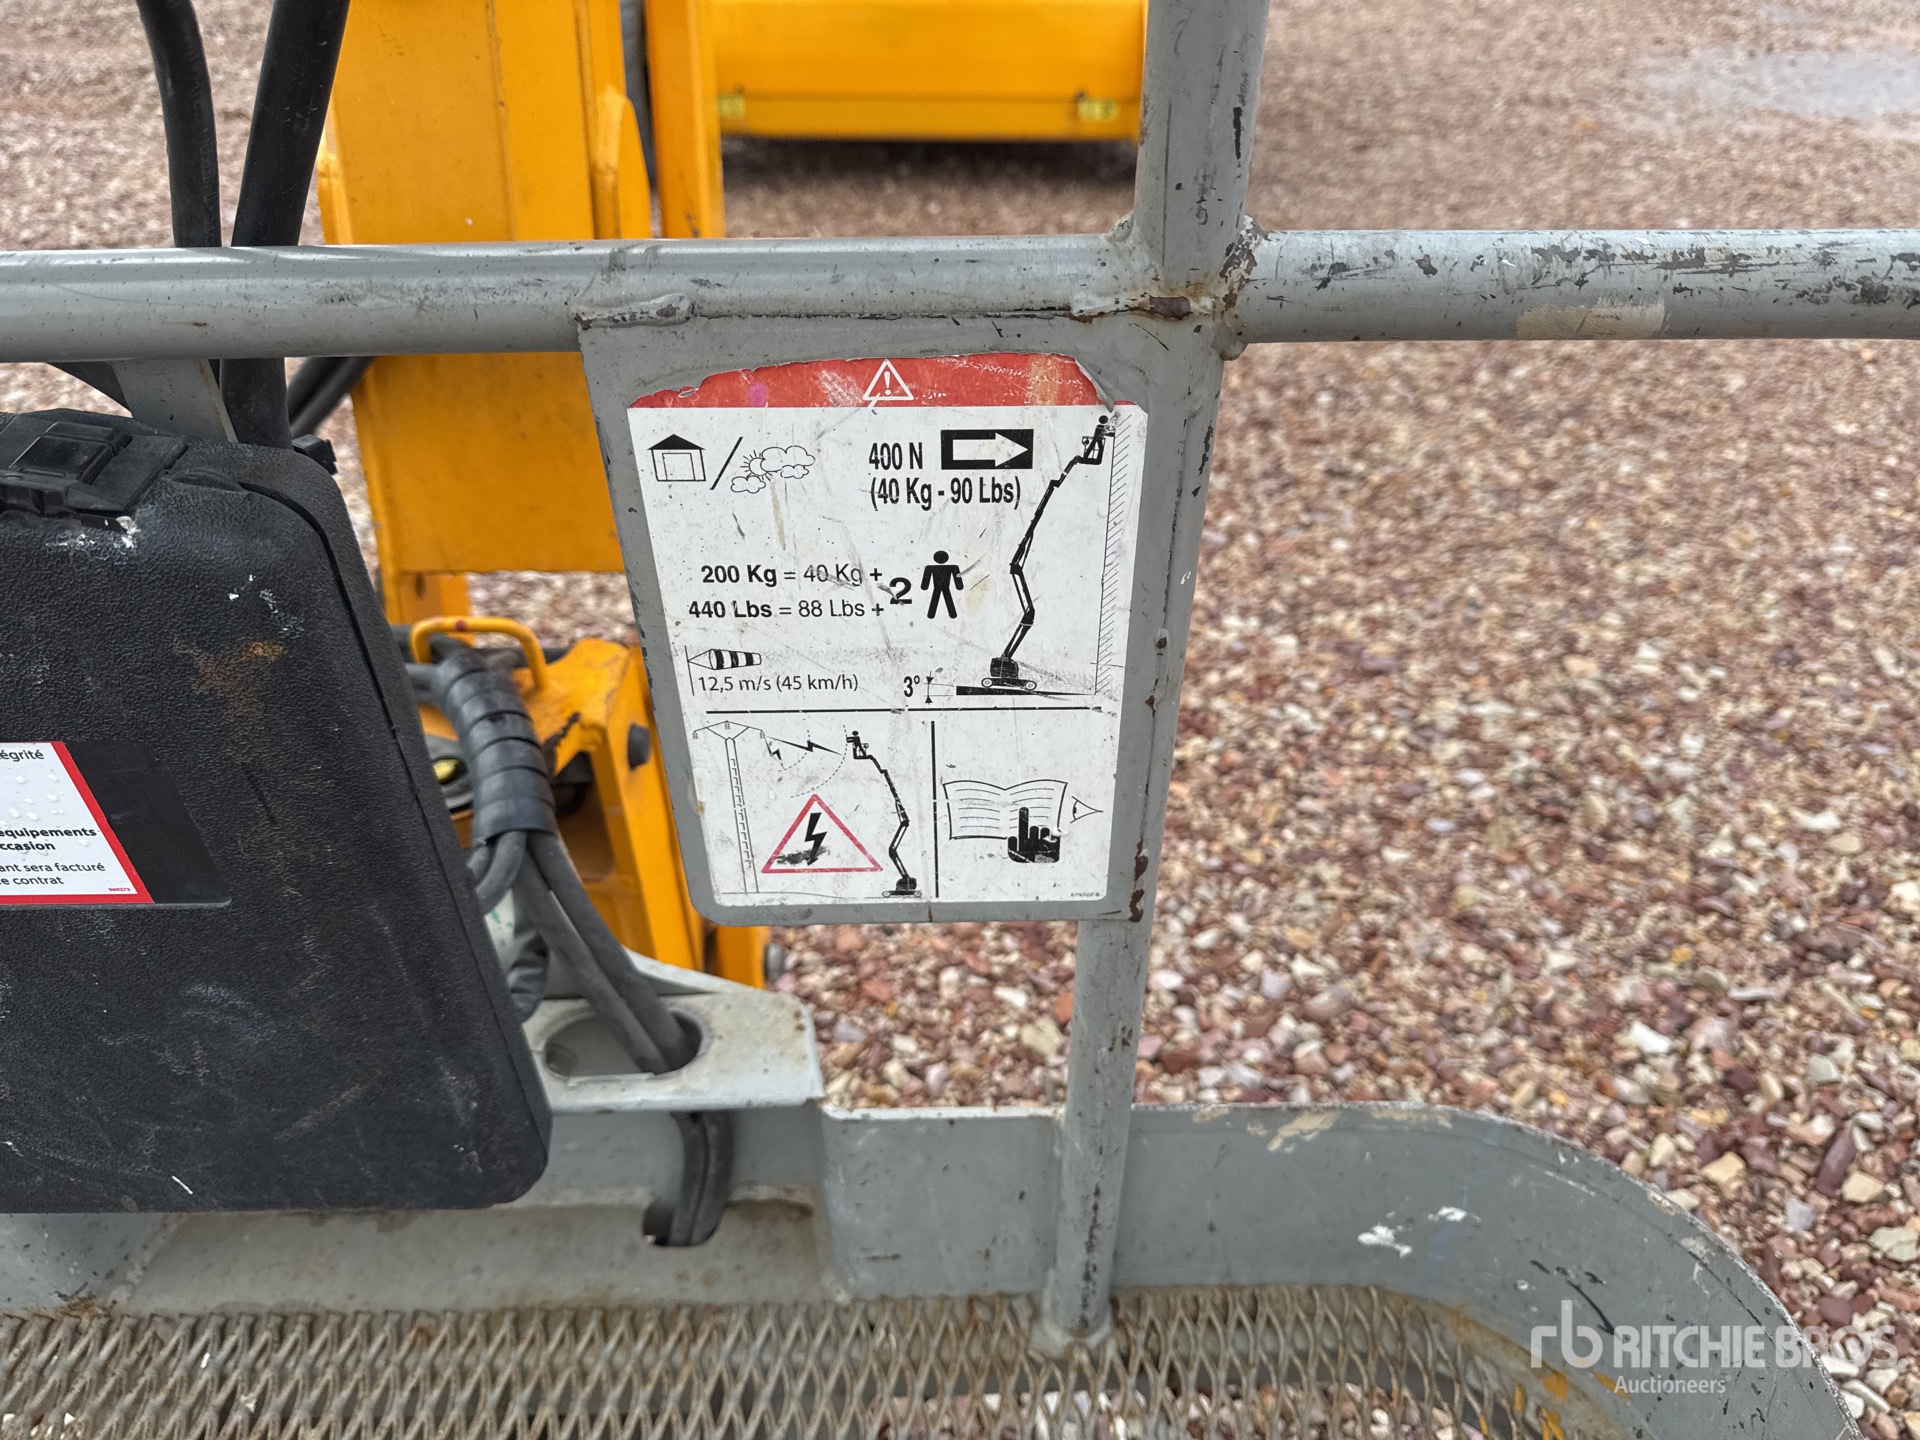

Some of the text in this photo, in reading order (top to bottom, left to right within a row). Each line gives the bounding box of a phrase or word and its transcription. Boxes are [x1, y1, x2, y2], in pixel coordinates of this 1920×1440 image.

[868, 442, 924, 470] 400 N
[869, 476, 900, 511] (40
[905, 477, 932, 511] Kg
[950, 477, 973, 505] 90
[979, 476, 1021, 510] Lbs)
[701, 564, 740, 584] 200
[746, 564, 778, 588] Kg
[783, 570, 797, 580] =
[803, 564, 829, 583] 40
[835, 563, 864, 587] Kg
[888, 577, 913, 605] 2
[688, 600, 726, 619] 440
[732, 600, 773, 618] Lbs
[778, 607, 792, 615] =
[798, 600, 823, 618] 88
[829, 599, 866, 617] Lbs
[698, 674, 859, 694] 12,5 m/s (45 km/h)
[0, 749, 45, 762] égrité
[23, 864, 53, 872] sera
[54, 862, 106, 872] facturé
[13, 876, 64, 885] contrat
